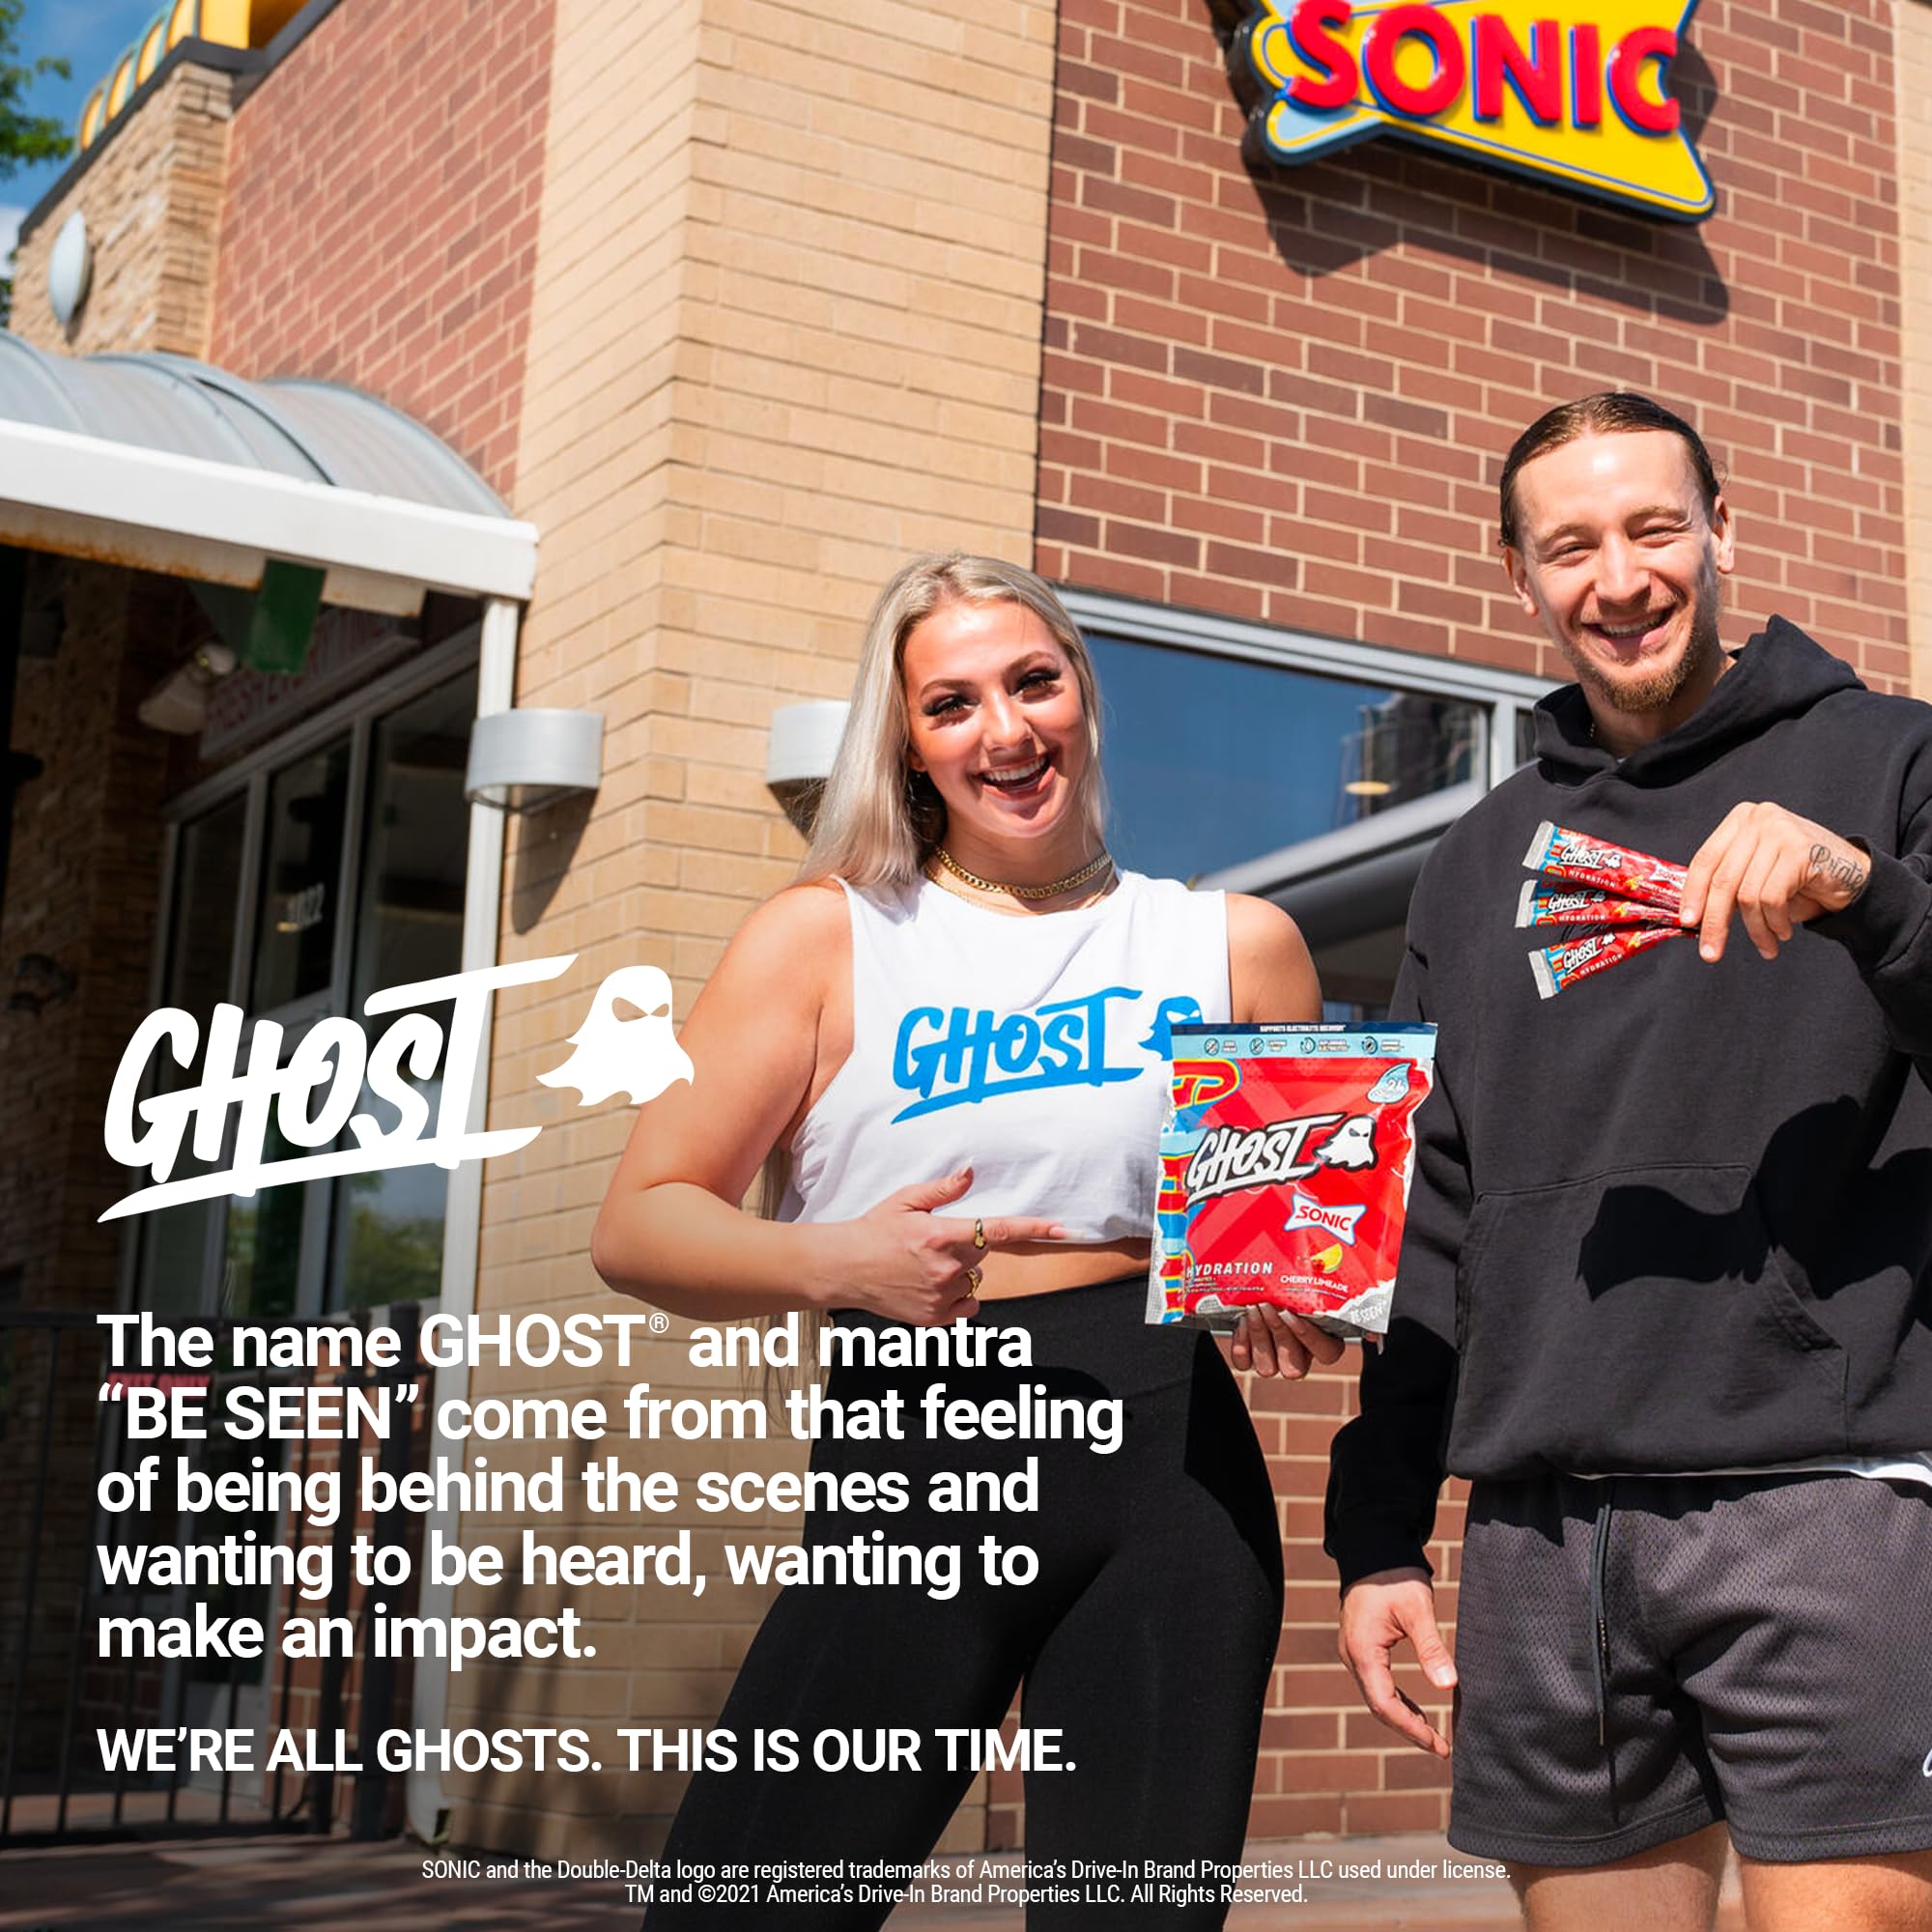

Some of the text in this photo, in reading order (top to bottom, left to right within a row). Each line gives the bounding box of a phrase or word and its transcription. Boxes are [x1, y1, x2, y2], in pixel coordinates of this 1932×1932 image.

[1280, 0, 1681, 138] SONIC
[1559, 842, 1613, 869] GHOST
[1569, 869, 1616, 889] HYDRATION
[1548, 890, 1595, 915] GHOST
[1563, 936, 1604, 974] GHOST
[1579, 952, 1623, 977] HYDRATION
[891, 986, 1144, 1124] GHOST
[1185, 1112, 1347, 1208] GHOST
[1295, 1205, 1351, 1232] SONIC
[1186, 1261, 1274, 1278] HYDRATION
[1280, 1274, 1314, 1285] CHERRY
[1314, 1277, 1349, 1293] LIMEADE
